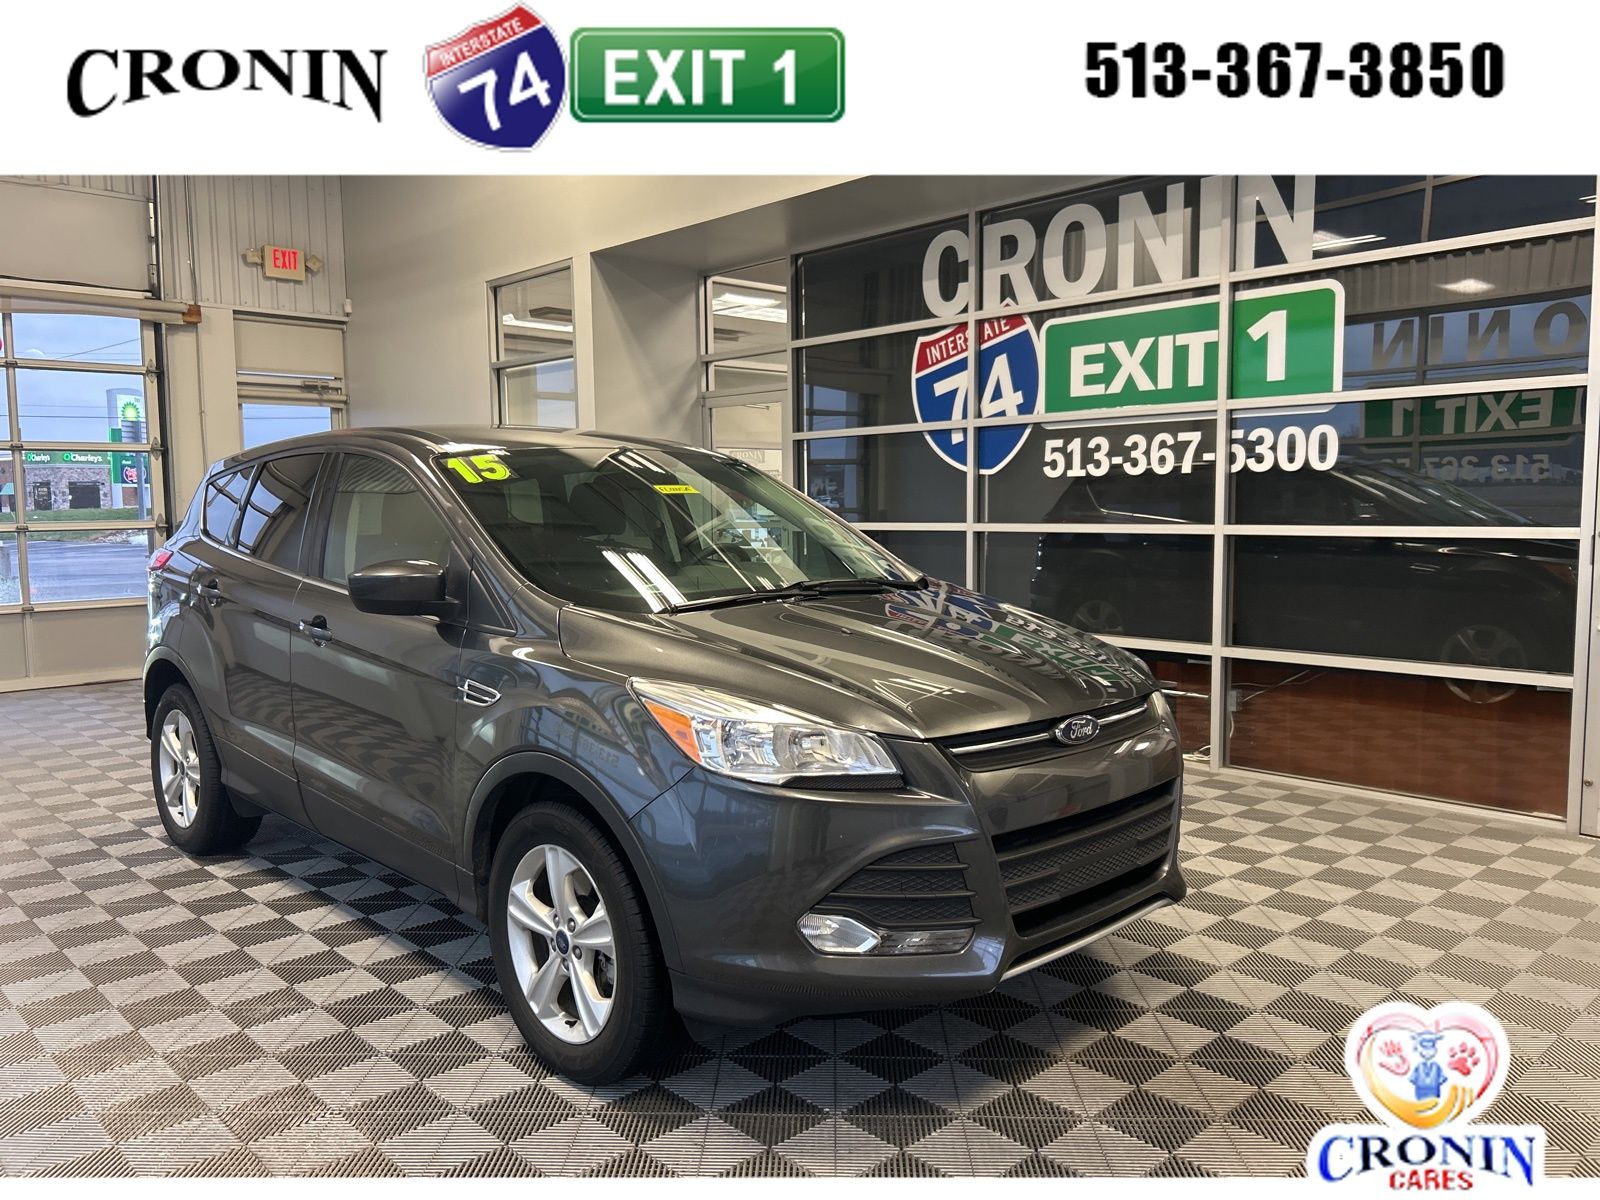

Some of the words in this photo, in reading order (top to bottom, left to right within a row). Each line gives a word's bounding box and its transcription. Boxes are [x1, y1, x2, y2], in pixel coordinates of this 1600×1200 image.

[272, 248, 298, 270] EXIT
[922, 174, 1316, 318] CRONIN
[1069, 330, 1219, 397] EXIT
[1246, 309, 1287, 382] 1
[933, 353, 1024, 445] 74
[447, 454, 512, 483] 15
[1042, 424, 1339, 479] 513-367-5300
[1070, 720, 1093, 739] Ford
